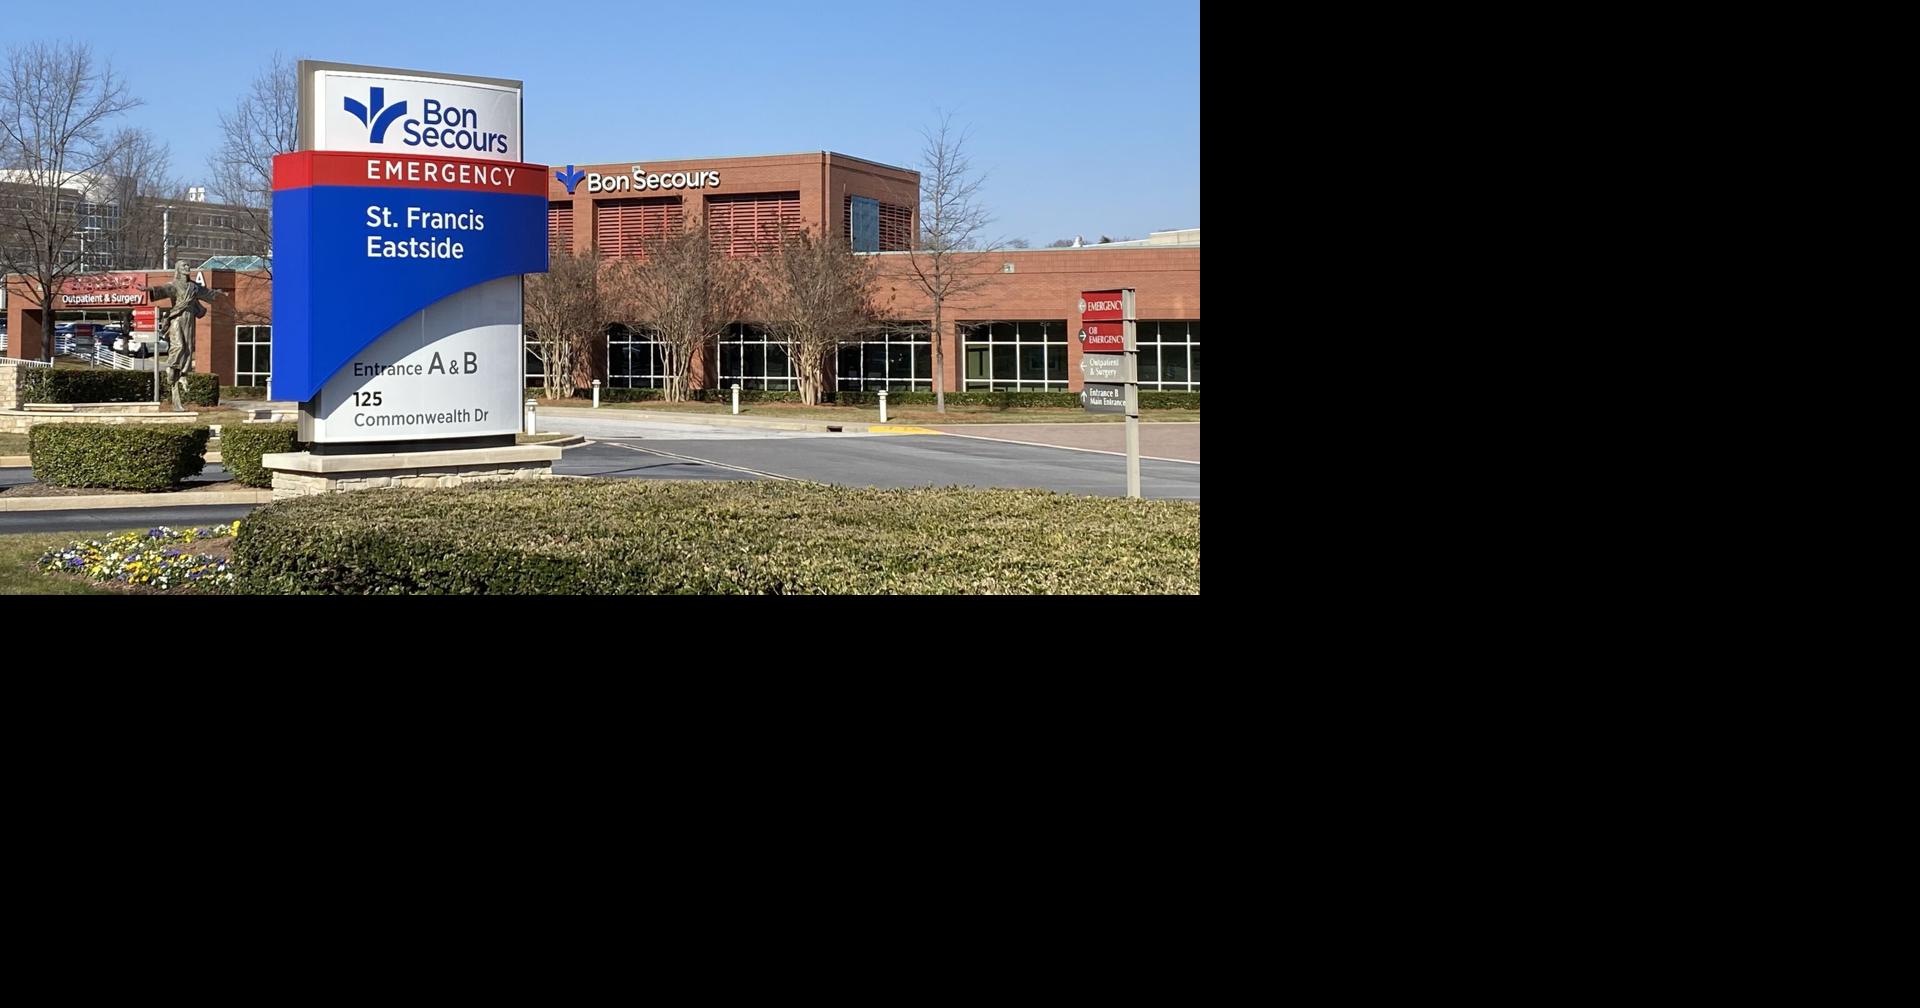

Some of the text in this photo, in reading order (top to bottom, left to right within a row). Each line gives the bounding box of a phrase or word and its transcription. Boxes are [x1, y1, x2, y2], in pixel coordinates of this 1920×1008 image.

[423, 98, 477, 129] Bon
[403, 119, 508, 154] Secours
[367, 159, 516, 187] EMERGENCY
[587, 169, 720, 192] Bon Secours
[366, 205, 485, 231] St. Francis
[367, 235, 464, 259] Eastside
[195, 271, 206, 287] A
[62, 293, 142, 305] Outpatient & Surgery
[1088, 300, 1123, 311] EMERGENCY
[1088, 335, 1124, 344] EMERGENCY
[353, 351, 478, 377] Entrance A & B
[352, 391, 383, 407] 125
[1089, 387, 1114, 397] Entrance
[354, 408, 489, 427] Commonwealth Dr
